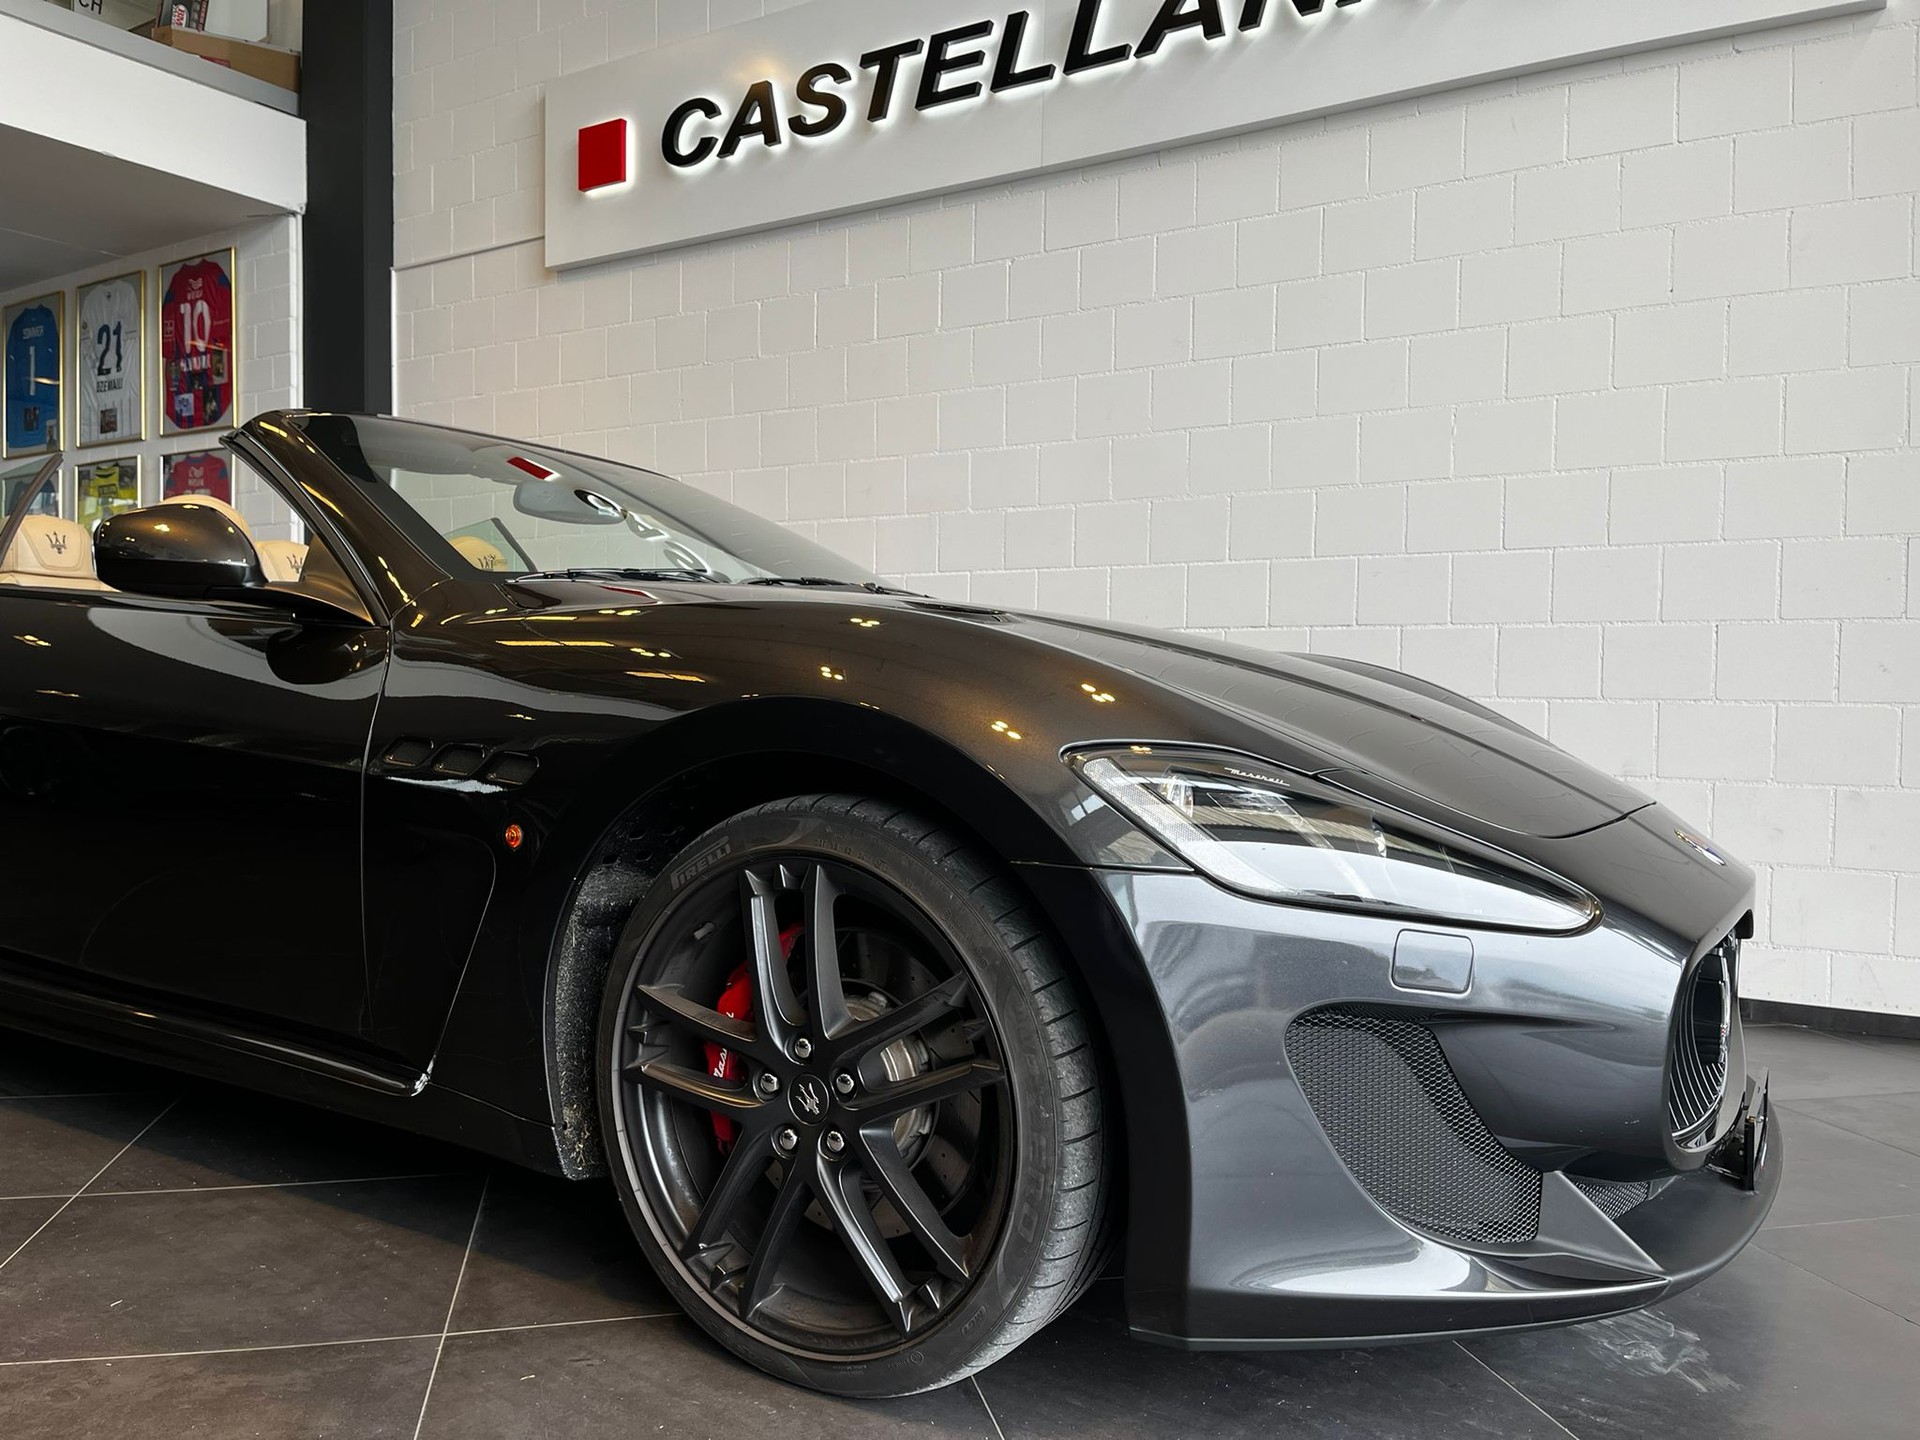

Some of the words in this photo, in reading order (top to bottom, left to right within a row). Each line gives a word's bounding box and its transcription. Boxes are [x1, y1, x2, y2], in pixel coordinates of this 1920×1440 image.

[661, 0, 1362, 168] CASTELLA
[97, 321, 123, 376] 21
[180, 300, 211, 354] 10
[29, 346, 36, 396] 1
[670, 836, 731, 890] PIRELLI
